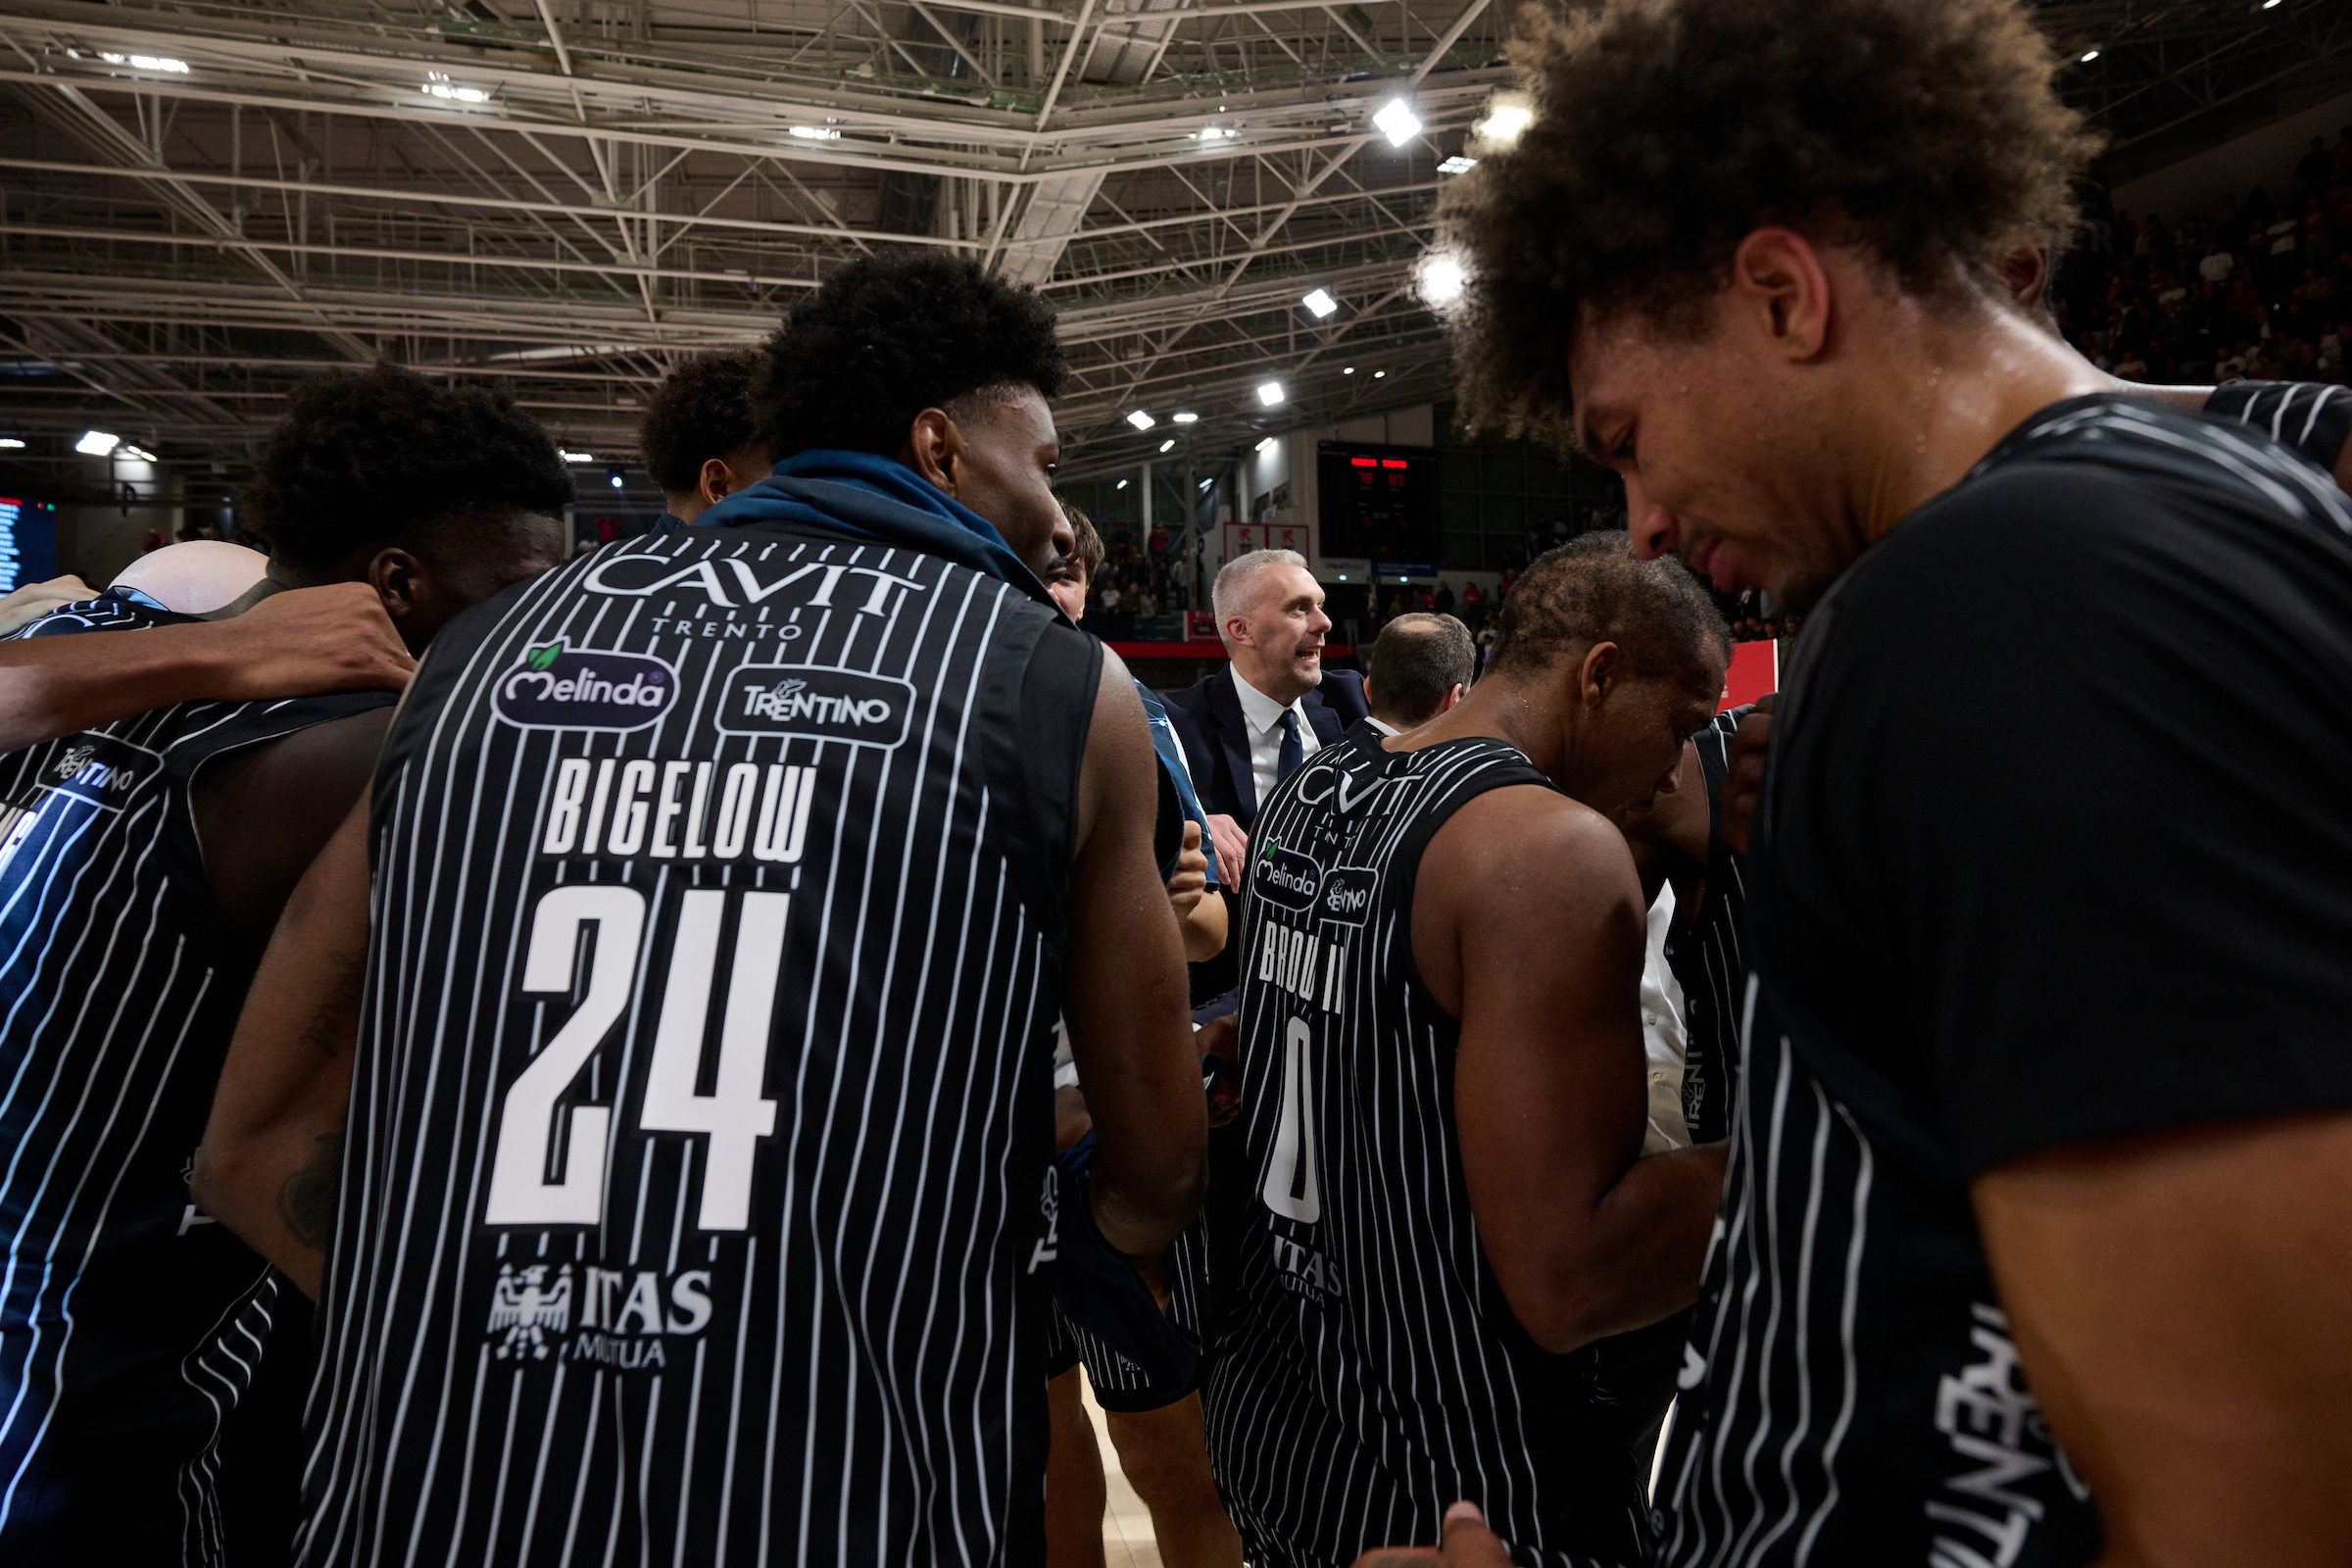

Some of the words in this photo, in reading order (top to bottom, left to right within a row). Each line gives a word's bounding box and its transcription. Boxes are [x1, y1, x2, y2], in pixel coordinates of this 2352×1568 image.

[583, 554, 926, 617] CAVIT
[651, 616, 802, 641] TRENTO
[505, 670, 665, 708] Melinda
[743, 683, 891, 727] TRENTINO
[542, 757, 817, 863] BIGELOW
[1256, 858, 1316, 897] Melinda
[484, 884, 791, 1232] 24
[1262, 1015, 1320, 1224] 0
[1274, 1234, 1343, 1298] ITAS
[1280, 1273, 1325, 1309] UTUA
[578, 1265, 713, 1336] ITAS
